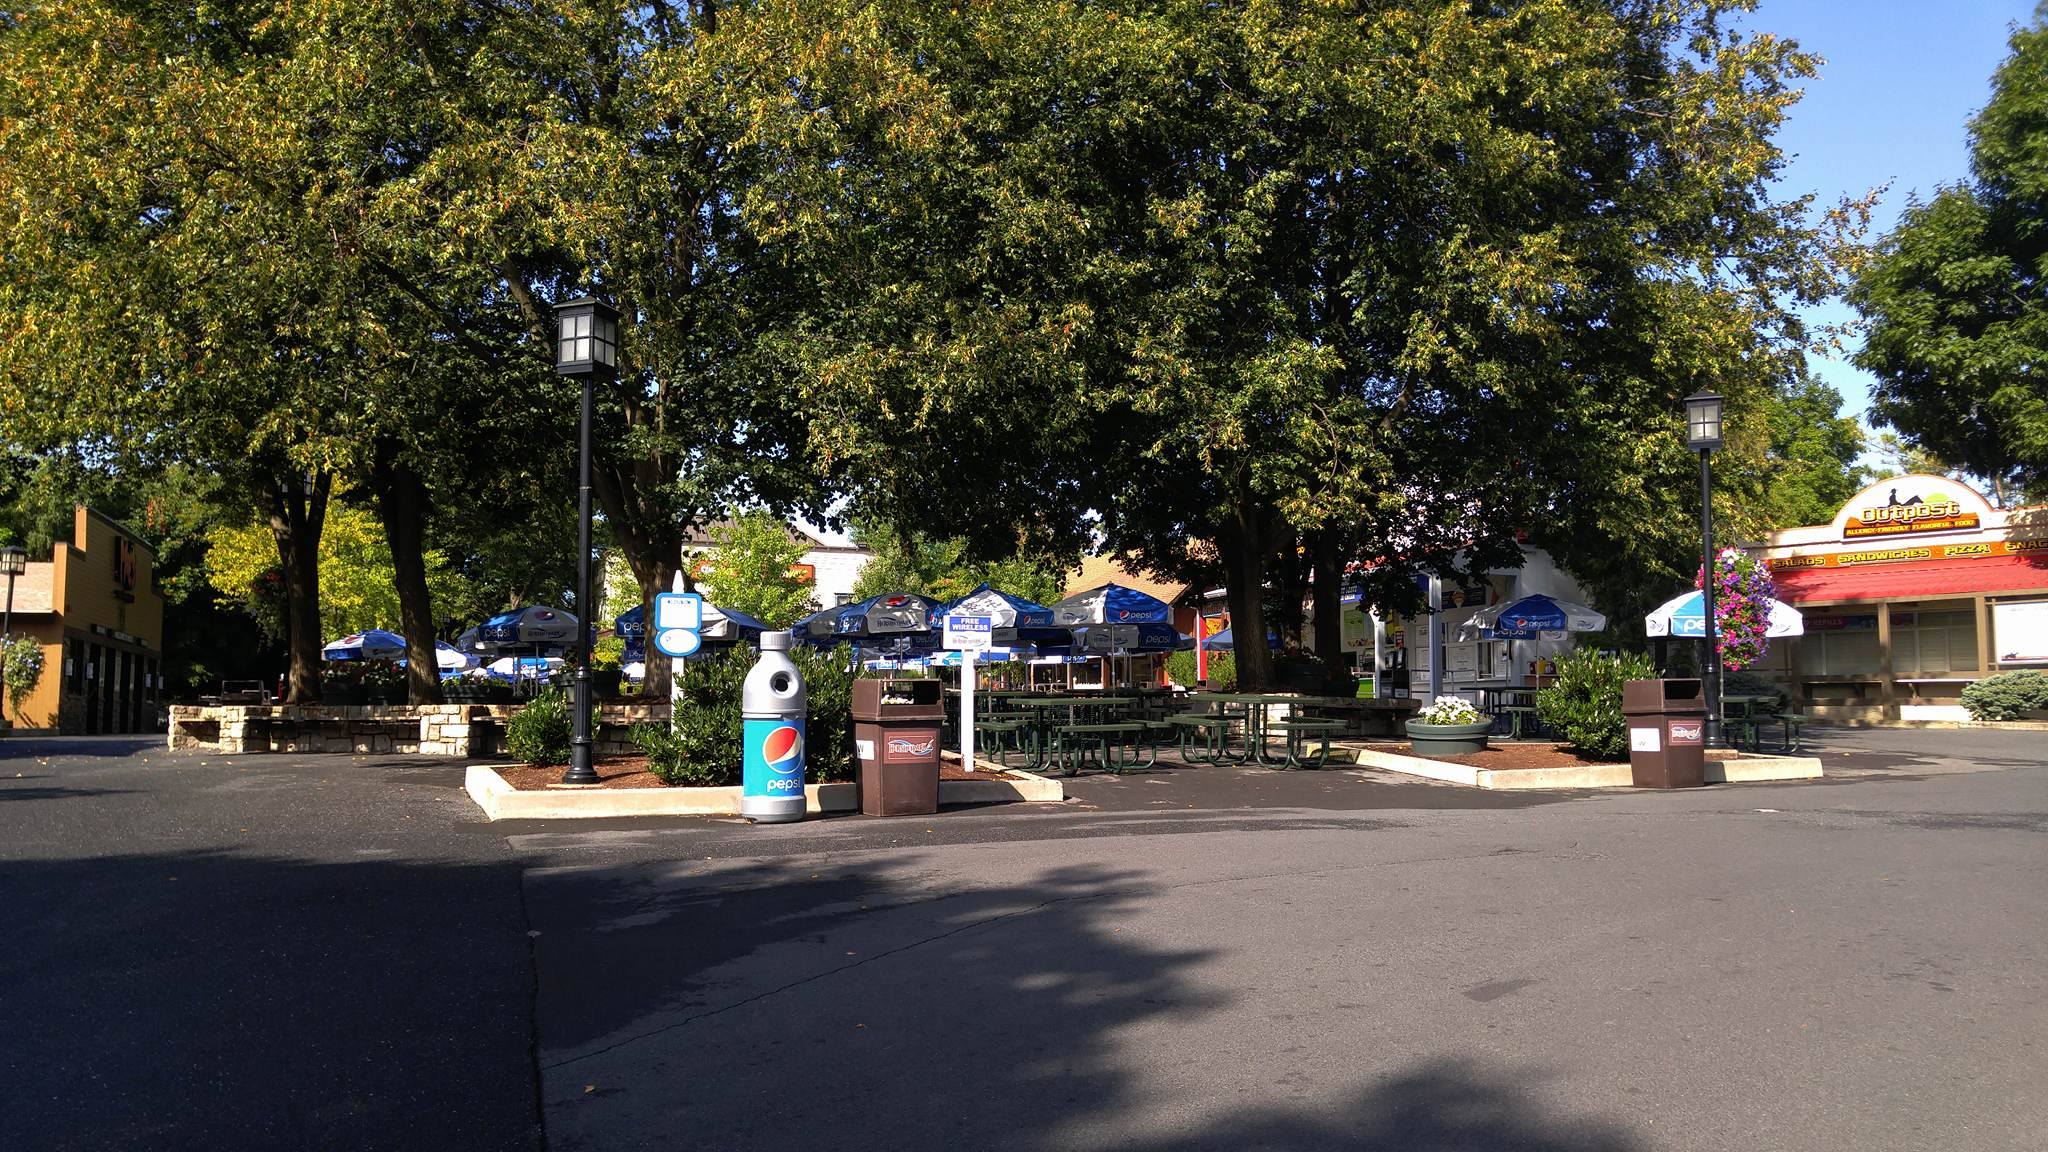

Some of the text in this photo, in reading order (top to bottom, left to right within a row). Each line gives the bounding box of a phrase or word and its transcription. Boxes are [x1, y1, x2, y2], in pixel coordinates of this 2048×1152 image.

[1860, 501, 1960, 523] Outpost
[1955, 519, 1975, 527] FOOD
[1772, 557, 1825, 568] SALADS
[1838, 549, 1930, 564] SANDWICHES
[1944, 543, 1990, 556] PIZZA
[960, 617, 979, 625] FREE
[1130, 611, 1152, 620] pepsi
[624, 622, 645, 633] pep
[1529, 620, 1550, 628] pepsi
[485, 626, 510, 638] pepsi
[1145, 634, 1171, 645] pepsi
[766, 777, 801, 793] pepsi
